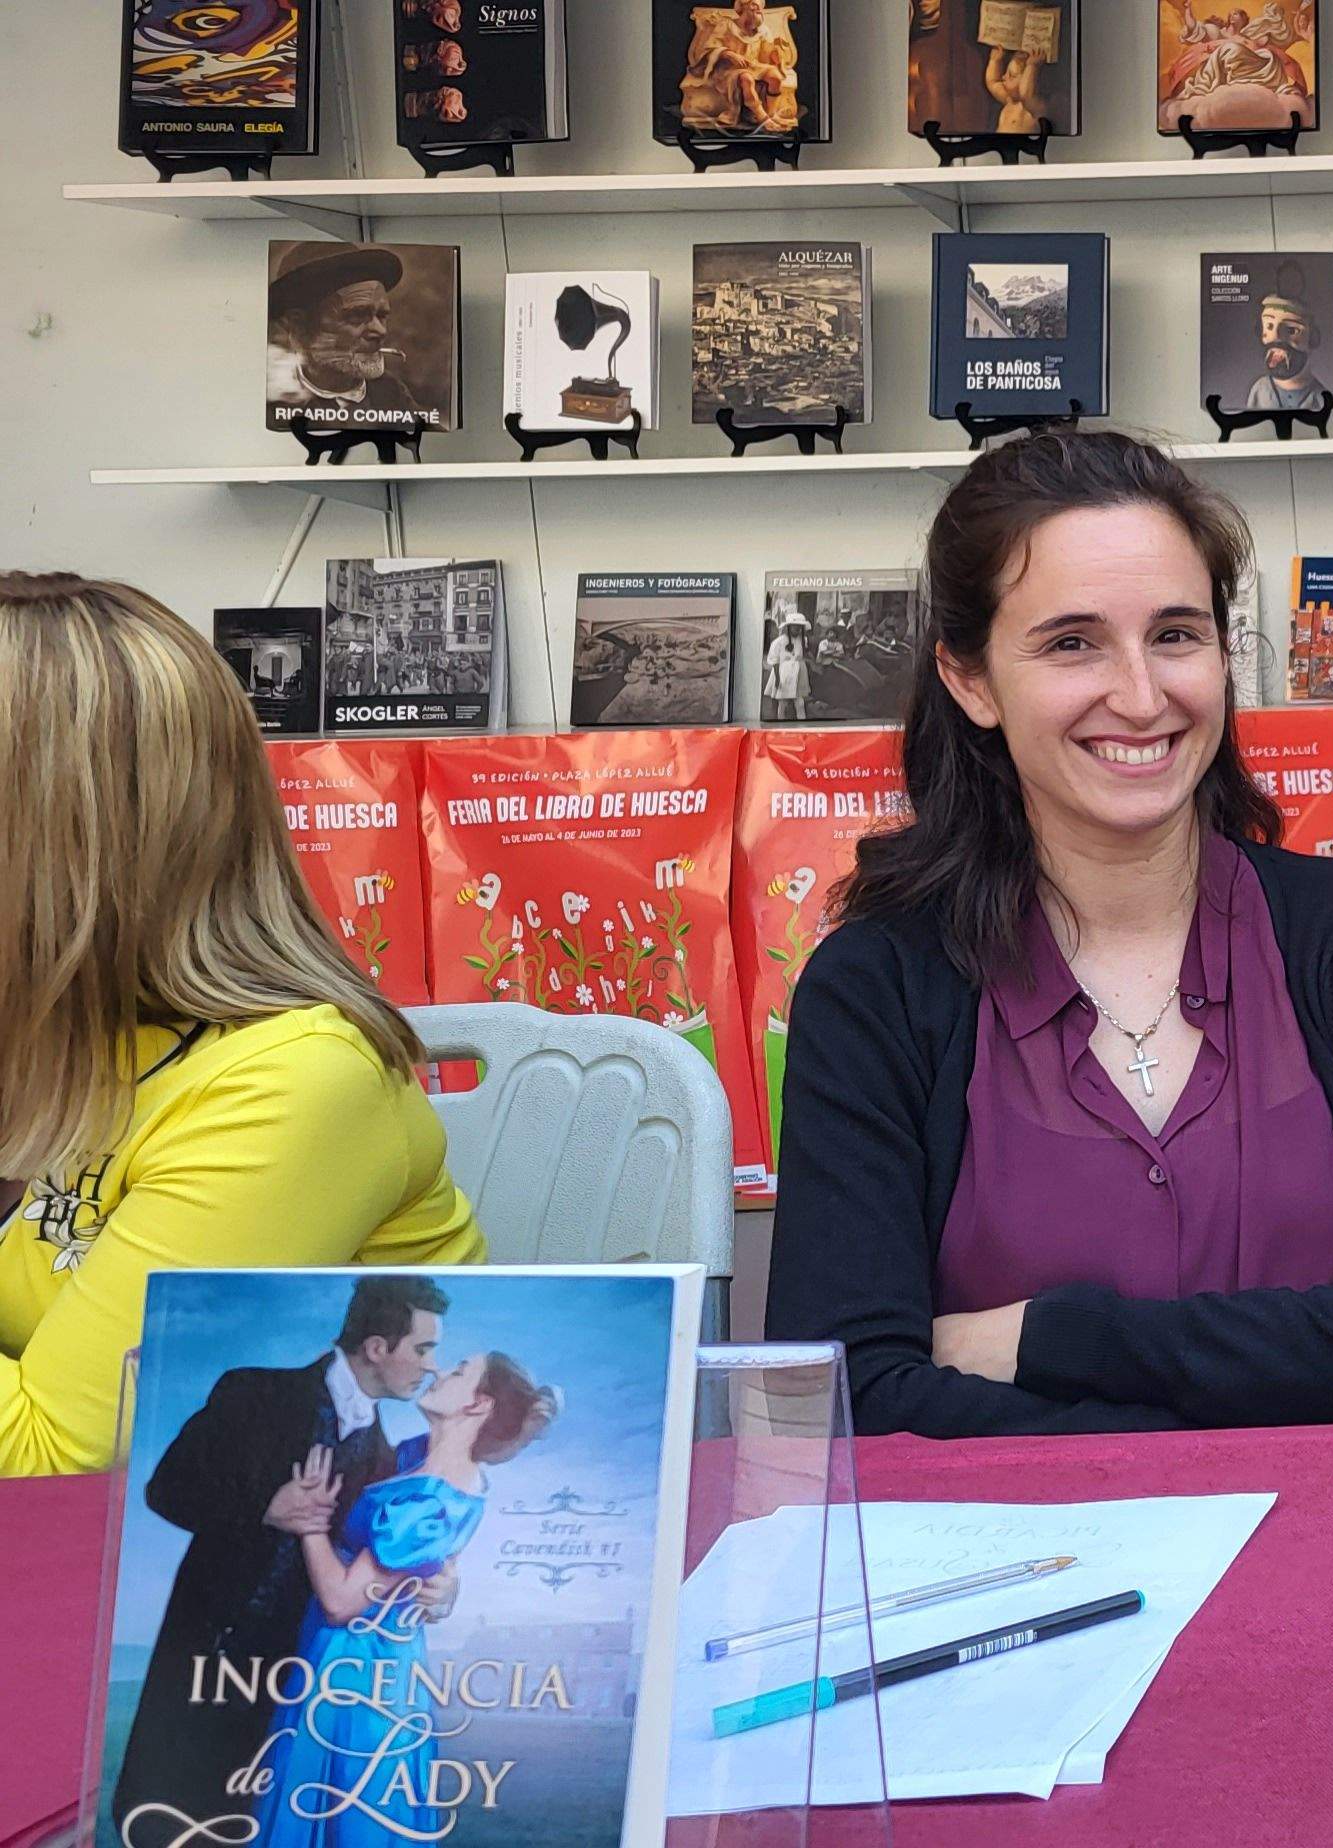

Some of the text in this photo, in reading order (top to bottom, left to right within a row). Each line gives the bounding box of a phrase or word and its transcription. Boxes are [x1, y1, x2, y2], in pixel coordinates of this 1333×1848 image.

[479, 5, 538, 28] Signos
[142, 121, 284, 133] ANTONIO SAURA ELEGÍA
[778, 249, 853, 264] ALQUÉZAR
[1211, 265, 1232, 274] ARTE
[1211, 274, 1249, 283] INGENUO
[967, 362, 993, 375] LOS
[997, 359, 1041, 375] BAÑOS
[967, 376, 1061, 390] DE PANTICOSA
[353, 408, 440, 424] COMPARÉ
[586, 576, 721, 588] INGENIEROS Y FOTÓGRAFOS
[773, 578, 823, 587] FELICIANO
[825, 577, 863, 587] LLANAS
[335, 704, 419, 722] SKOGLER
[422, 703, 446, 712] ÁNGEL
[1283, 741, 1319, 756] ALLUÉ
[472, 764, 673, 783] 39 EDICIÓN PLAZA LÓPEZ ALLUÉ
[804, 767, 819, 779] 39
[822, 766, 870, 779] EDICIÓN
[280, 776, 355, 789] ÓPEZ ALLUÉ
[448, 788, 708, 825] FERIA DEL LIBRO DE HUESCA
[770, 792, 828, 818] FERIA
[834, 791, 869, 818] DEL
[284, 802, 398, 830] DE HUESCA
[511, 834, 521, 843] DE
[545, 832, 555, 841] AL
[564, 831, 576, 840] DE
[578, 829, 604, 839] JUNIO
[607, 829, 619, 838] DE
[297, 842, 331, 852] DE 2023
[348, 1576, 424, 1643] La
[188, 1655, 574, 1709] INOCENCIA
[226, 1690, 518, 1841] de LADY
